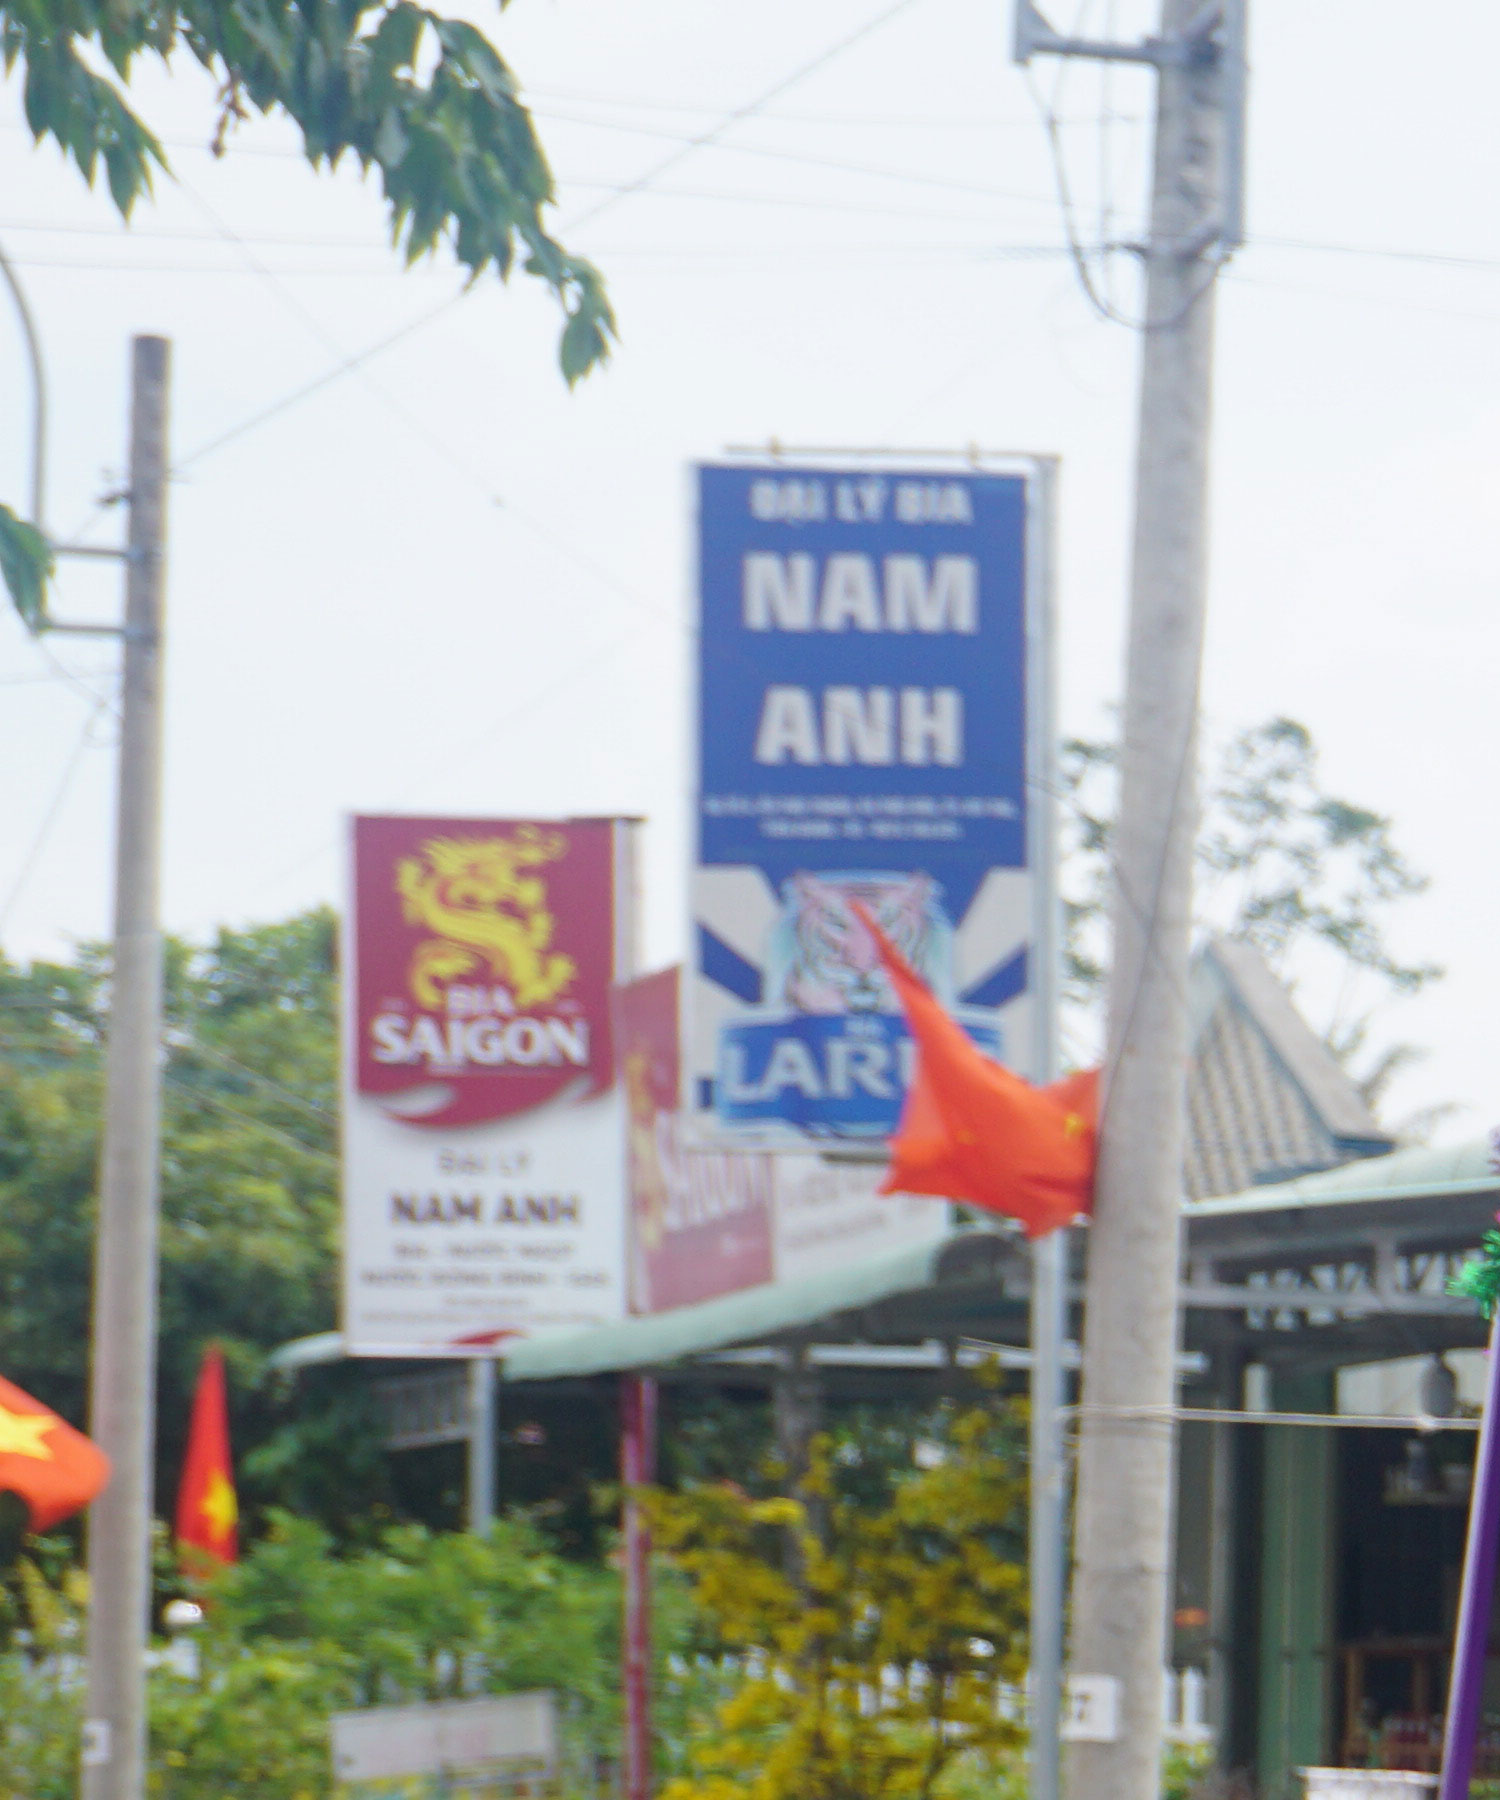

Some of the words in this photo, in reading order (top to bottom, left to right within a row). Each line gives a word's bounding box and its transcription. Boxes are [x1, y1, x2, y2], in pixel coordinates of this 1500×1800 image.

[896, 481, 972, 524] BIA
[742, 551, 980, 634] NAM
[754, 685, 965, 768] ANH
[371, 1013, 590, 1067] SAIGON
[722, 1036, 918, 1102] LAR
[390, 1192, 483, 1226] NAM
[495, 1193, 581, 1226] ANH
